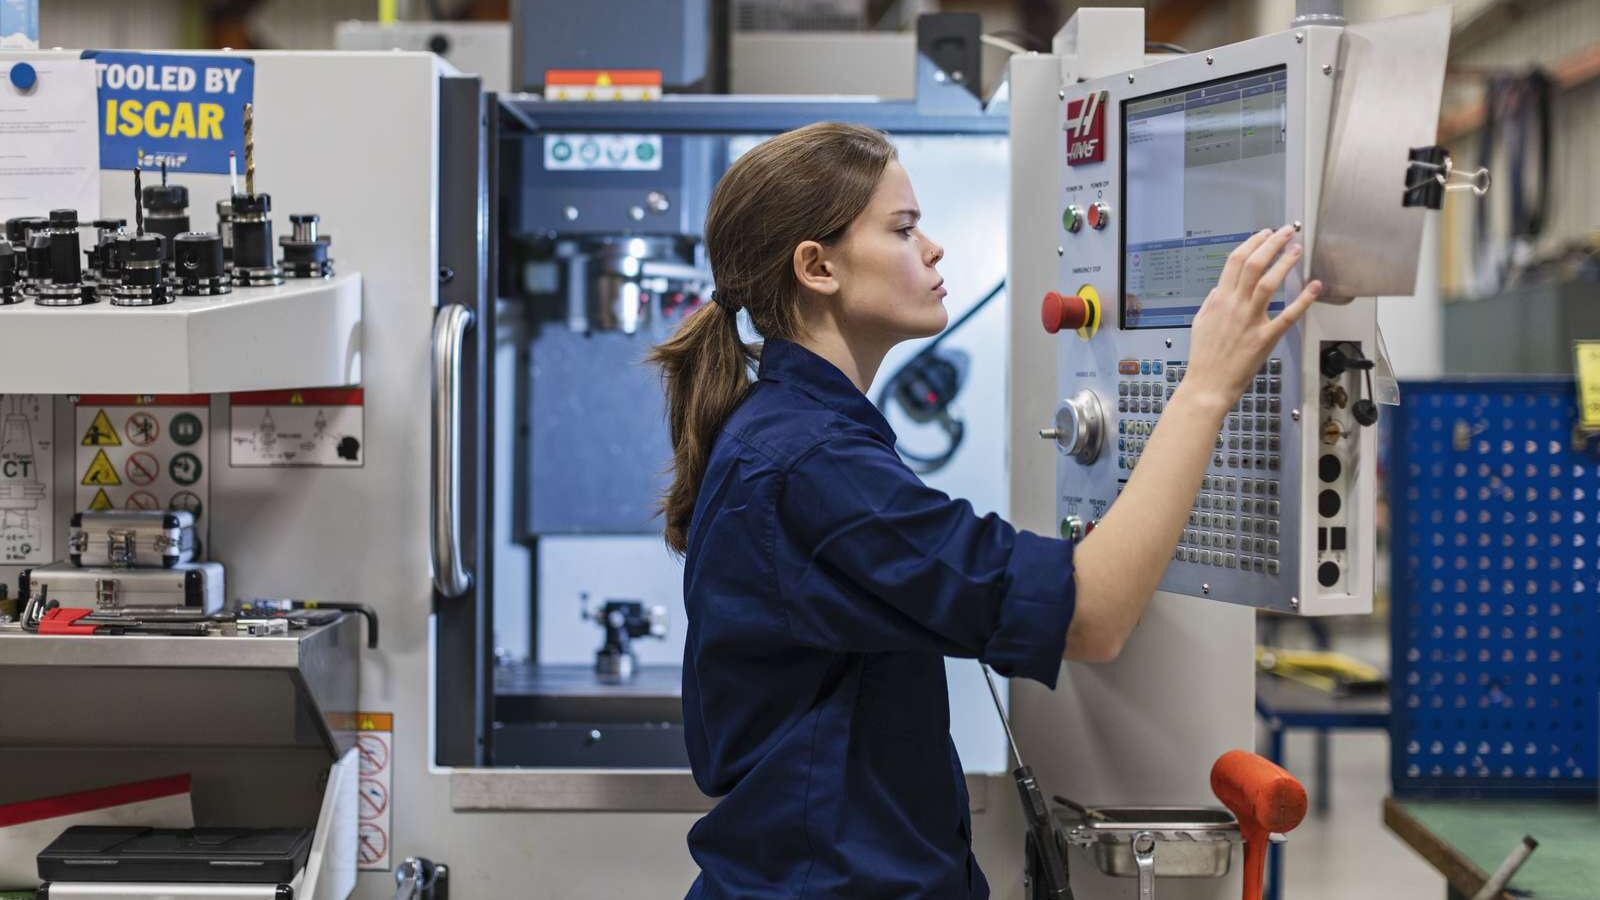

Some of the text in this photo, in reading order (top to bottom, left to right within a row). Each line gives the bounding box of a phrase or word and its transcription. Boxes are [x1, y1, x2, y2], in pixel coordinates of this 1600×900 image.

[96, 63, 242, 94] TOOLED BY
[105, 99, 225, 140] ISCAR
[3, 460, 33, 478] CT
